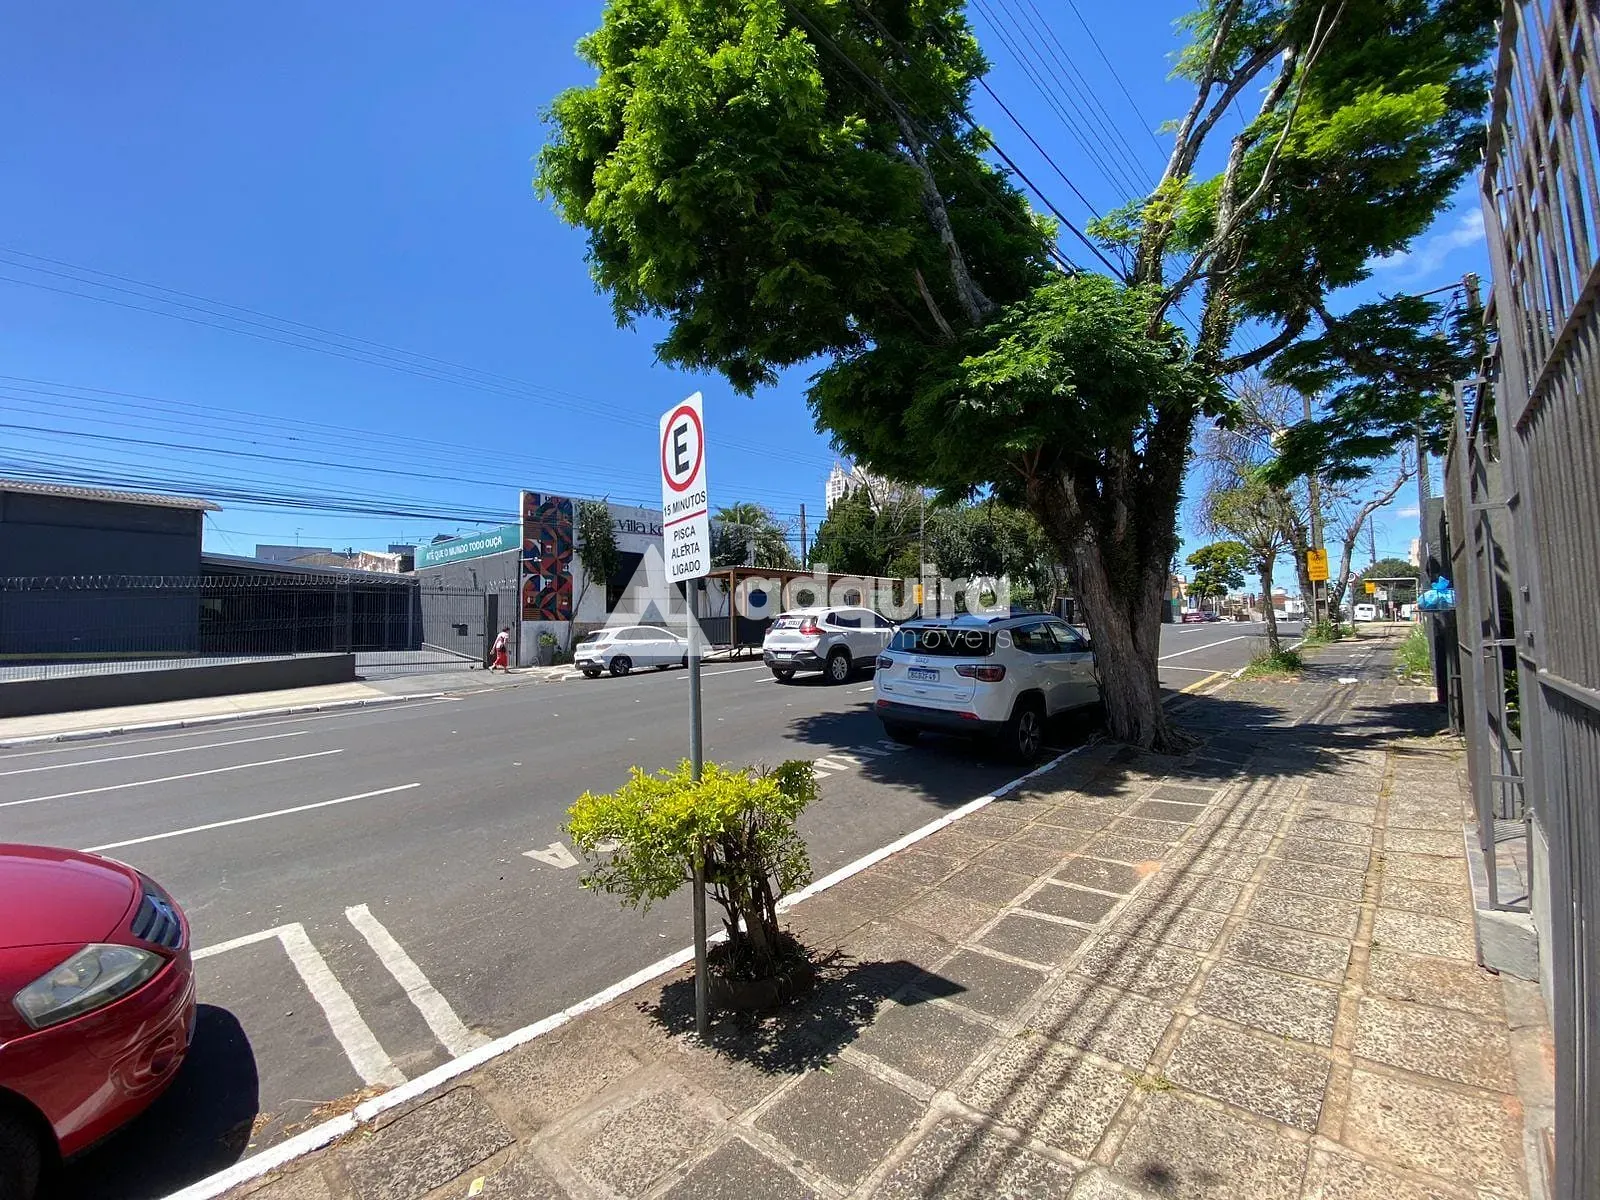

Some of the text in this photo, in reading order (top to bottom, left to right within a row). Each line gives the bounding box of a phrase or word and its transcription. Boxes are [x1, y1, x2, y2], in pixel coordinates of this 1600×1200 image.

[673, 422, 690, 476] E
[664, 490, 706, 517] 15 MINUTOS
[618, 519, 646, 533] Villa
[673, 525, 696, 542] PISCA
[449, 543, 469, 556] MUNDO
[469, 540, 484, 552] TODO
[485, 535, 503, 549] OUÇA
[671, 541, 701, 560] ALERTA
[672, 559, 701, 576] LIGADO
